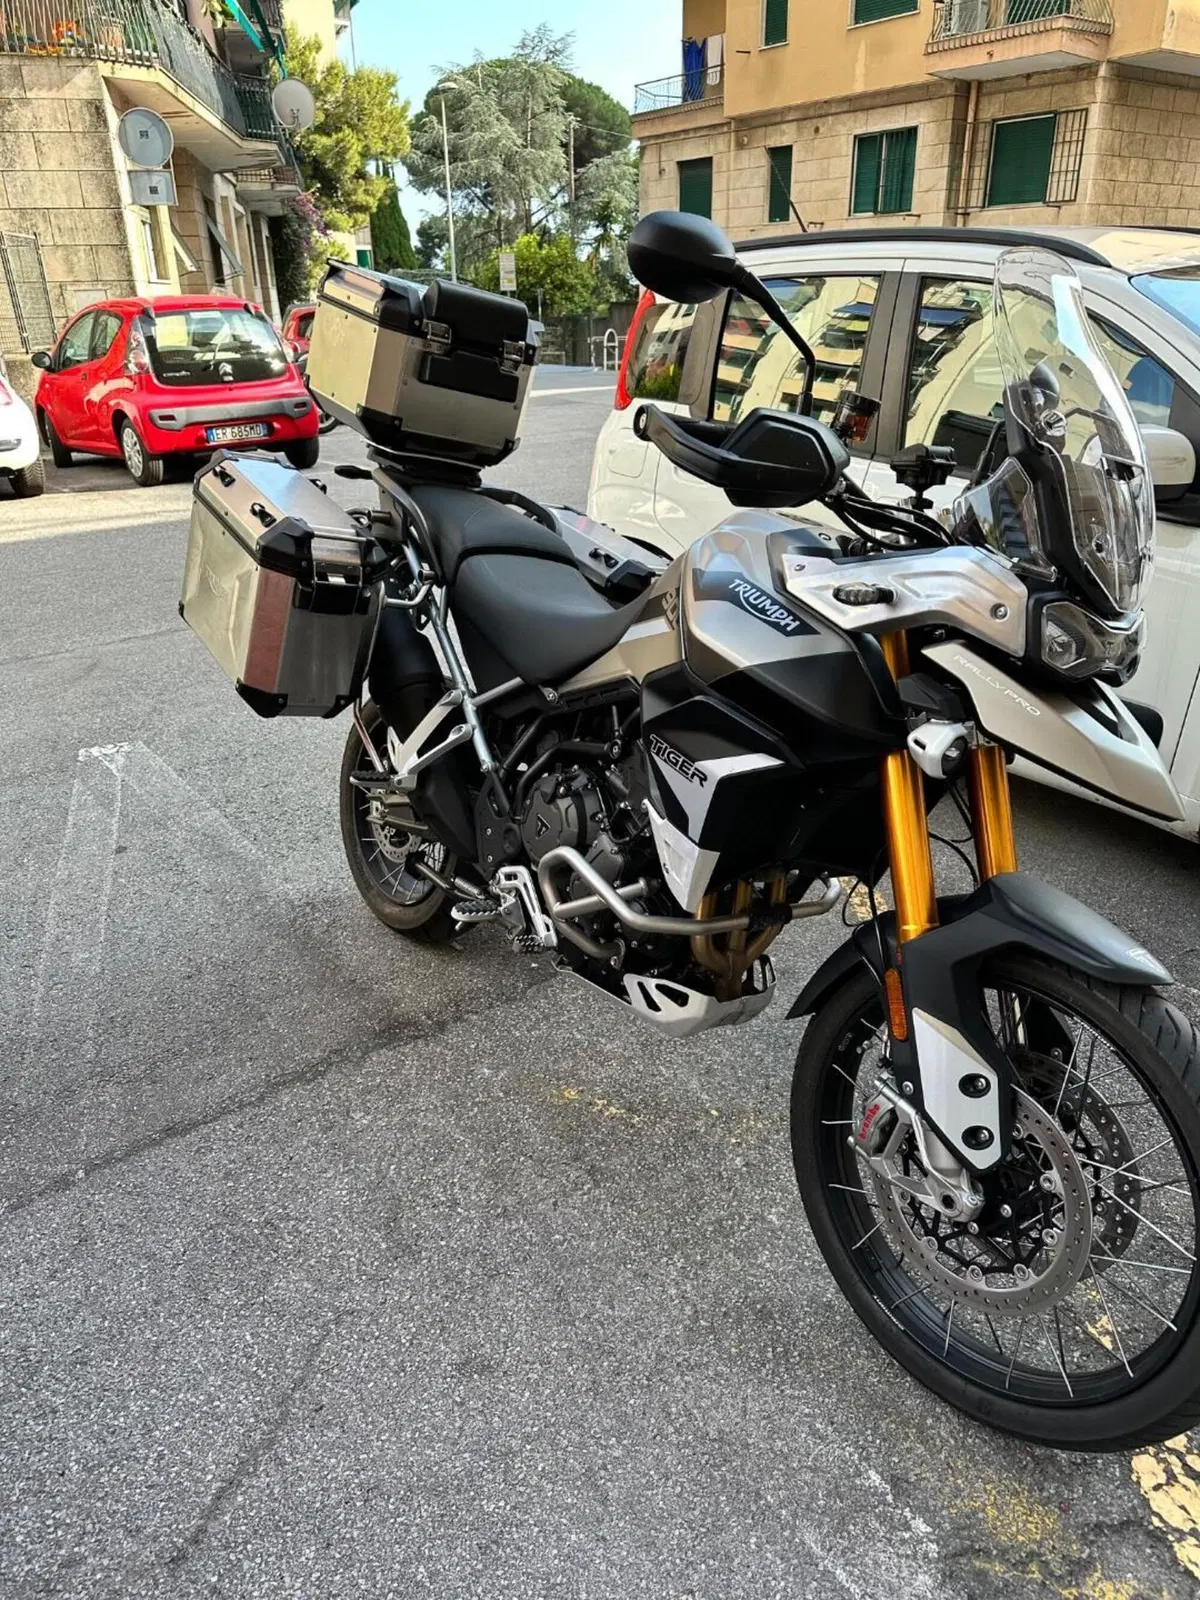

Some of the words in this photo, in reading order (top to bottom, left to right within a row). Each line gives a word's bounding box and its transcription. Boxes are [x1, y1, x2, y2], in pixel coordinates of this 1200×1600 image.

[214, 427, 228, 440] ER
[728, 578, 800, 632] TRIUMPH
[953, 654, 1006, 690] RALLY
[1004, 689, 1041, 716] PRO
[650, 733, 708, 788] TIGER
[858, 1103, 881, 1141] brembo
